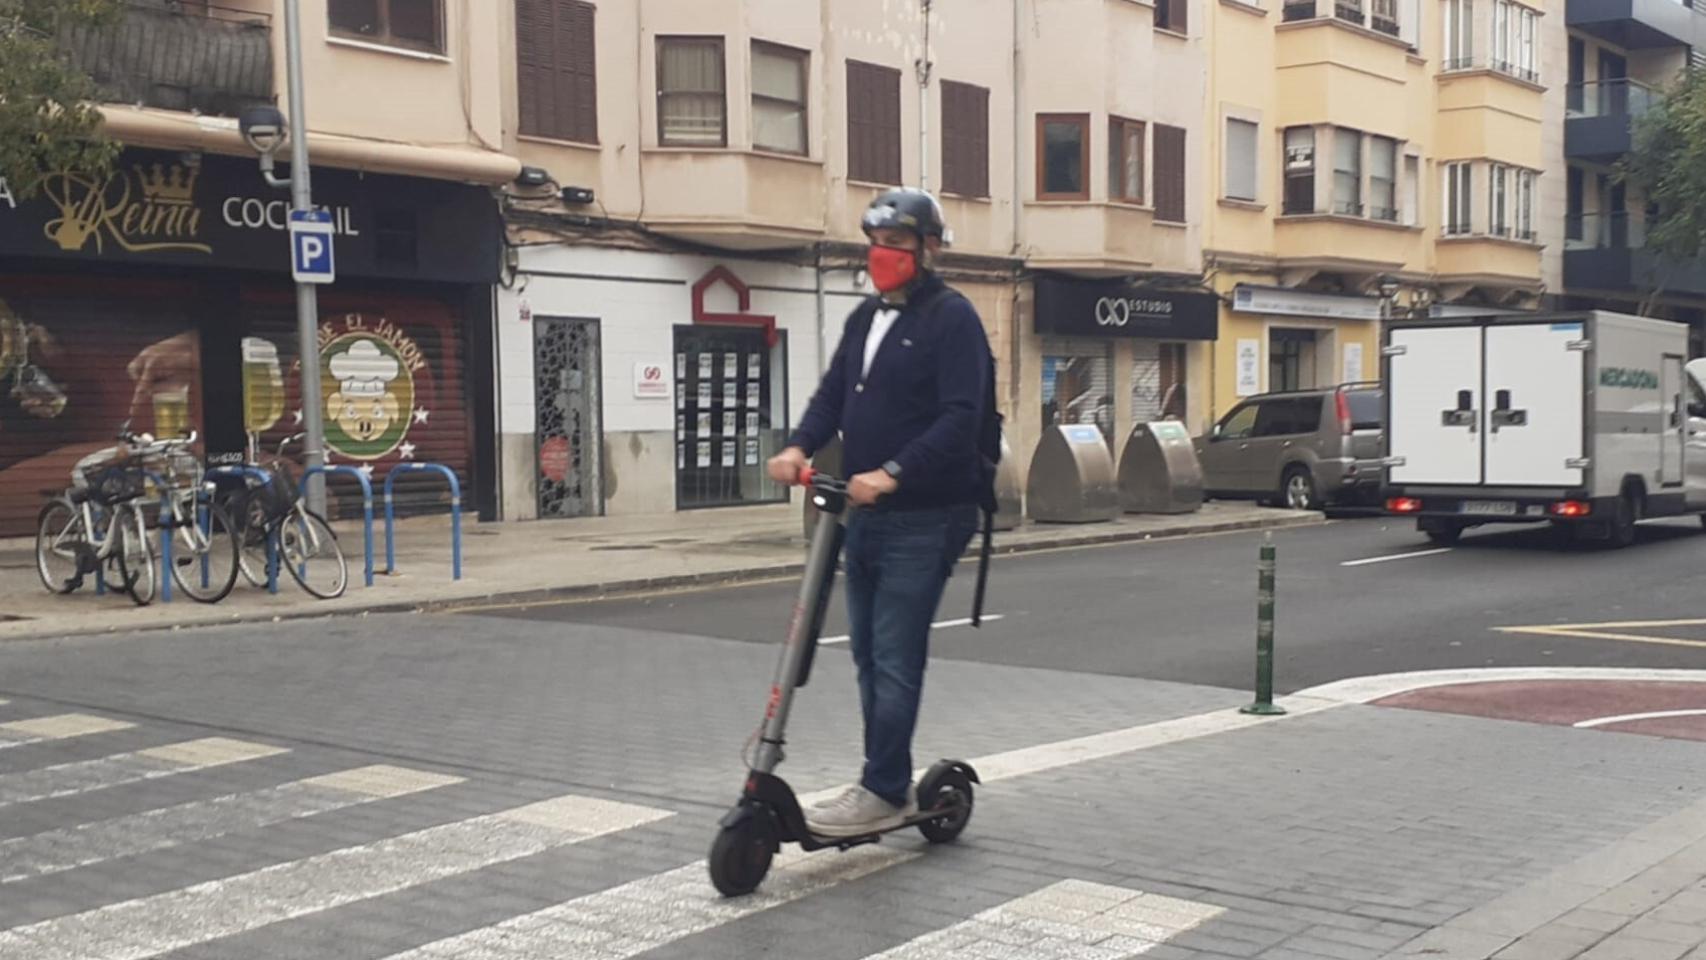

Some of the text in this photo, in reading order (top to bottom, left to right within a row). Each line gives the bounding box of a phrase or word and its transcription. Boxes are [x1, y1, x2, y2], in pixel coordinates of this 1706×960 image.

[301, 235, 323, 269] P
[345, 313, 367, 331] EL
[374, 318, 425, 372] JAMON
